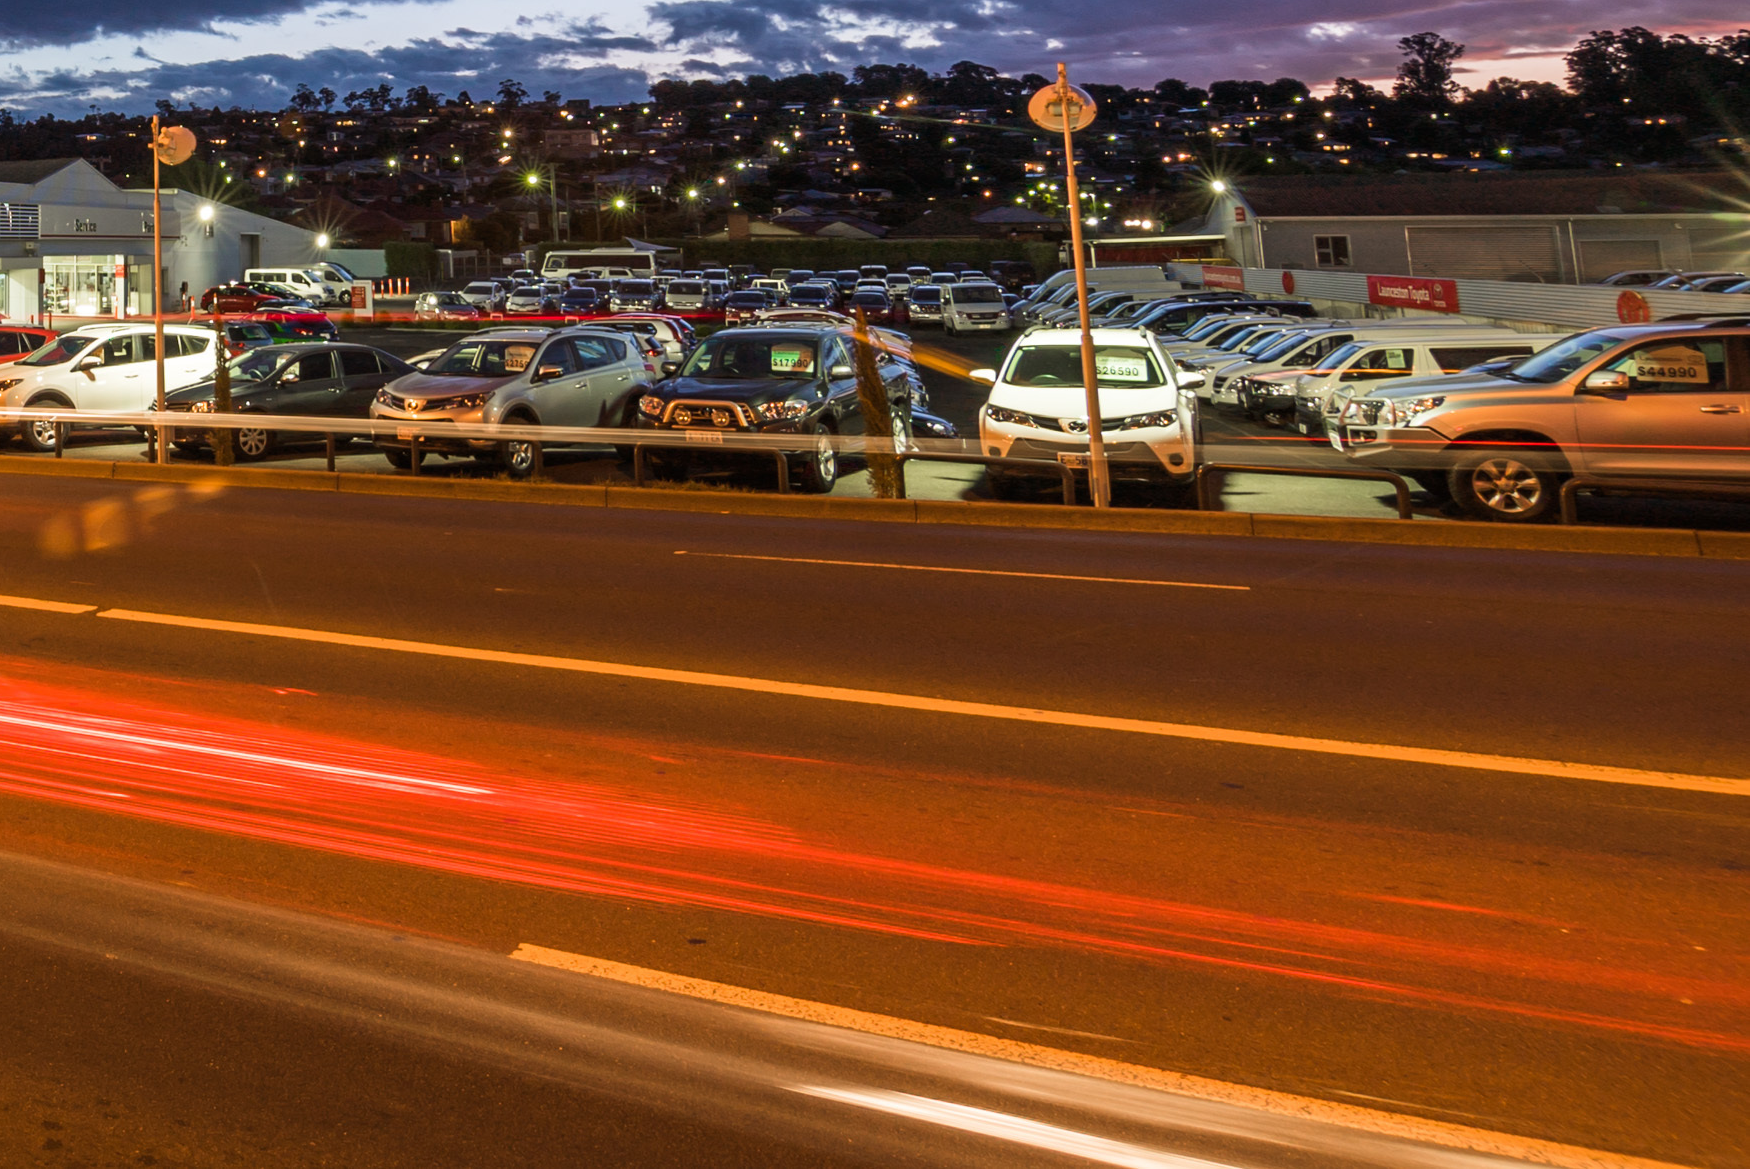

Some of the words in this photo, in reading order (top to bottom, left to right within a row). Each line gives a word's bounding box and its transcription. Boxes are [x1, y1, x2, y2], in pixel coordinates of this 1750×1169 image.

[74, 218, 98, 232] Service
[1376, 281, 1410, 299] Launceston
[1408, 285, 1430, 304] Toyota
[505, 359, 529, 368] $2759
[773, 358, 809, 368] $17990
[1096, 365, 1139, 376] $26590
[1638, 366, 1697, 378] $44990
